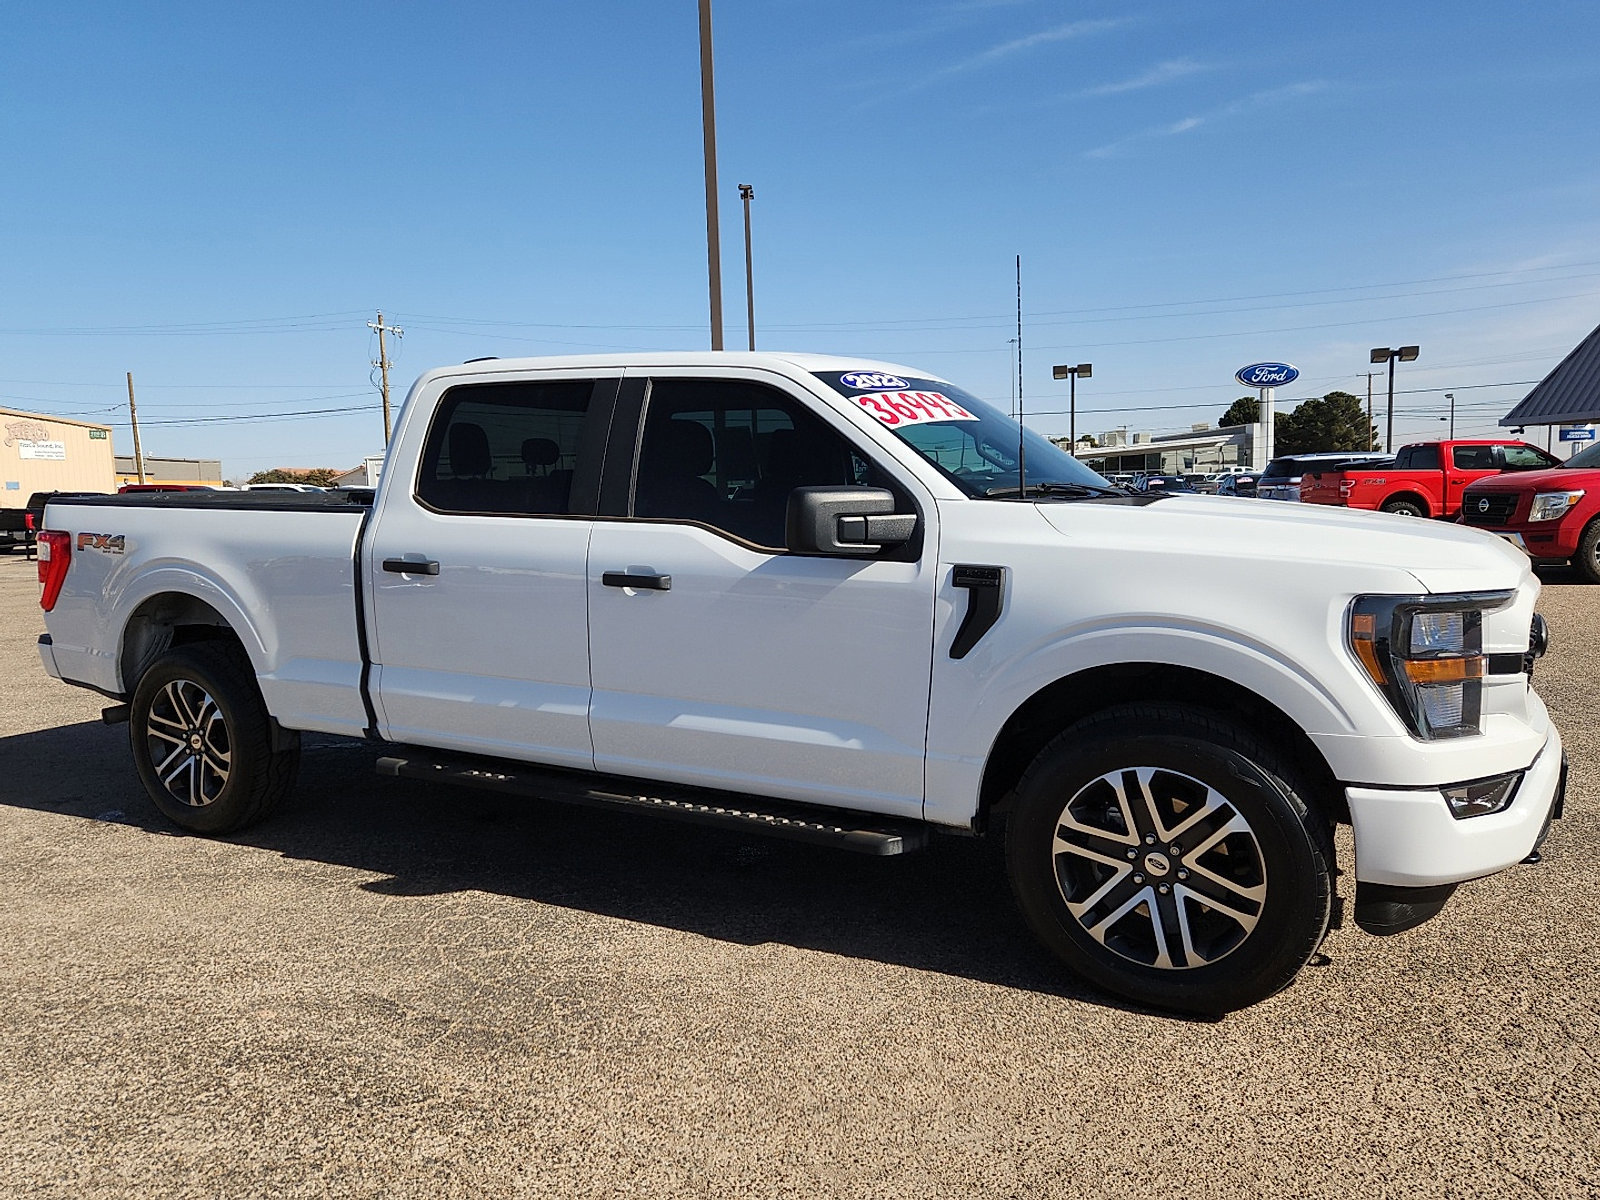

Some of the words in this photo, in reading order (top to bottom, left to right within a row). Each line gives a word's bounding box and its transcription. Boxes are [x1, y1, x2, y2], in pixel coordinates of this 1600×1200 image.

[1252, 366, 1288, 382] Ford
[859, 392, 969, 425] 36995
[77, 532, 126, 551] FX4
